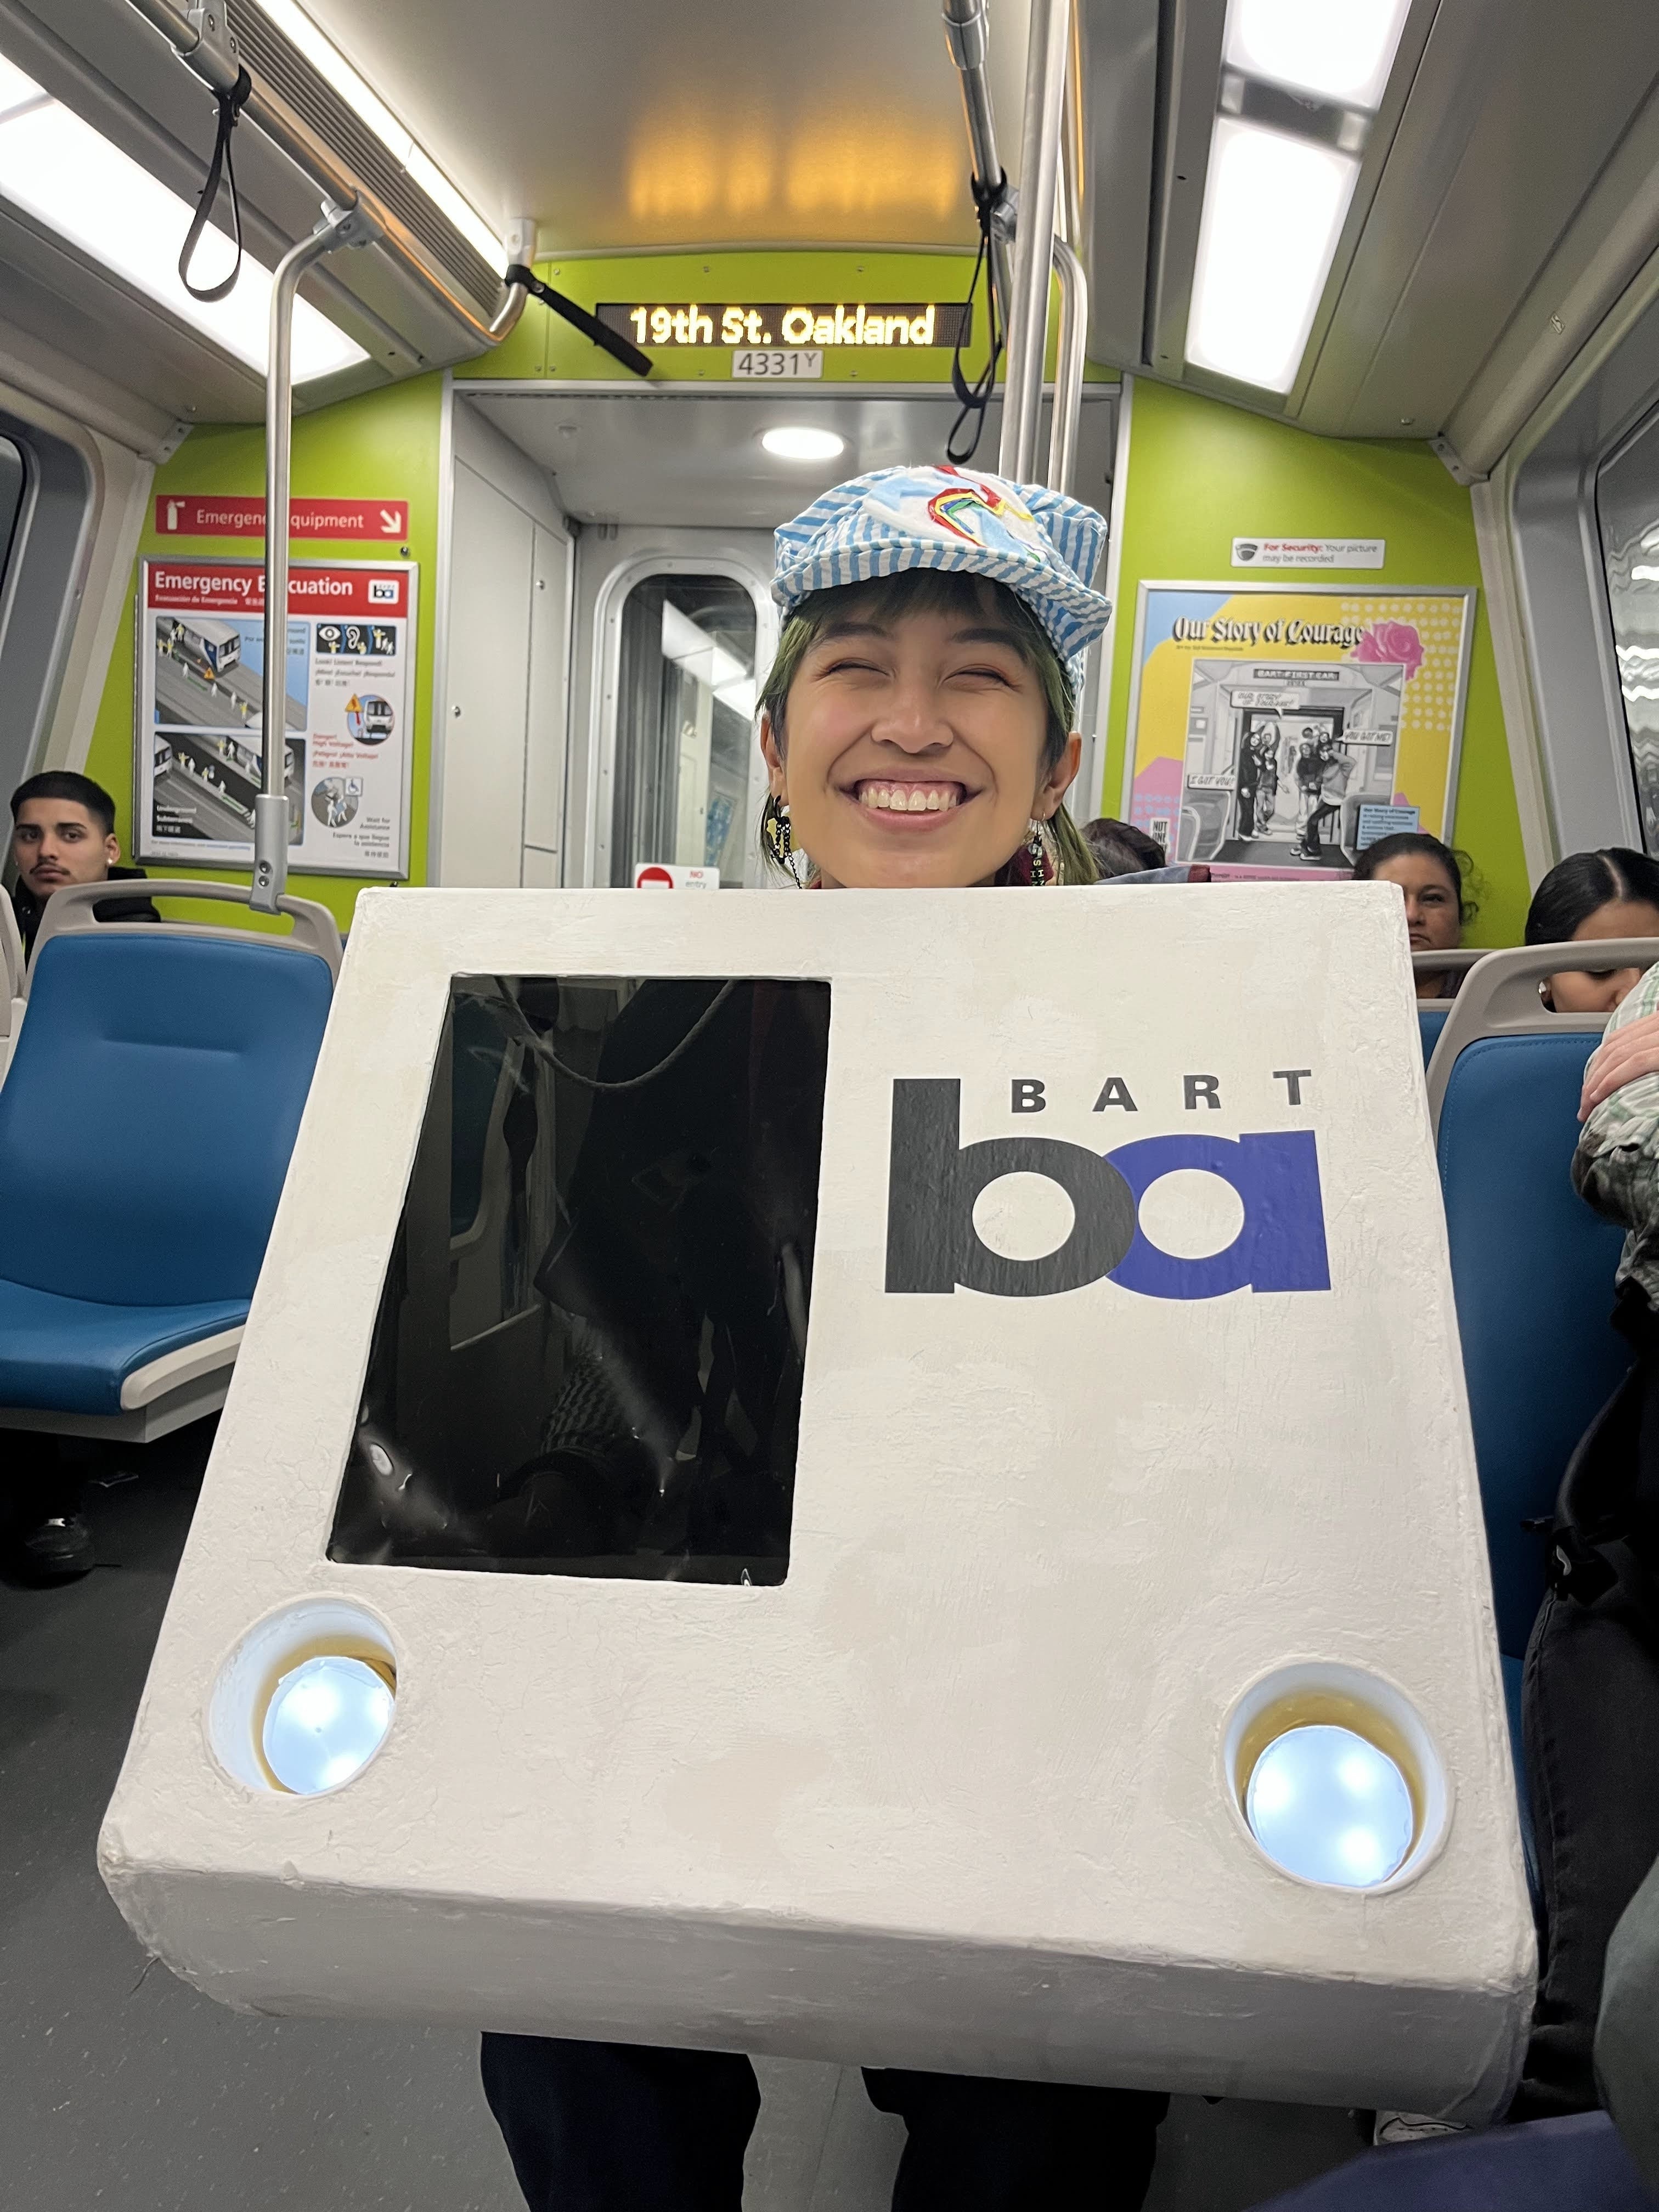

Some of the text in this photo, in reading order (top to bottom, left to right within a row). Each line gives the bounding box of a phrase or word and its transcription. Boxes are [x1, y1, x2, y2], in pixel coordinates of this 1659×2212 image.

[630, 303, 935, 345] 19th St. Oakland
[196, 509, 364, 531] Emergen quipment
[1263, 555, 1280, 563] may
[1282, 544, 1323, 554] Security:
[1346, 544, 1378, 554] picture
[155, 571, 353, 597] Emergency Ecuation
[1173, 615, 1364, 649] Our Story of Courage
